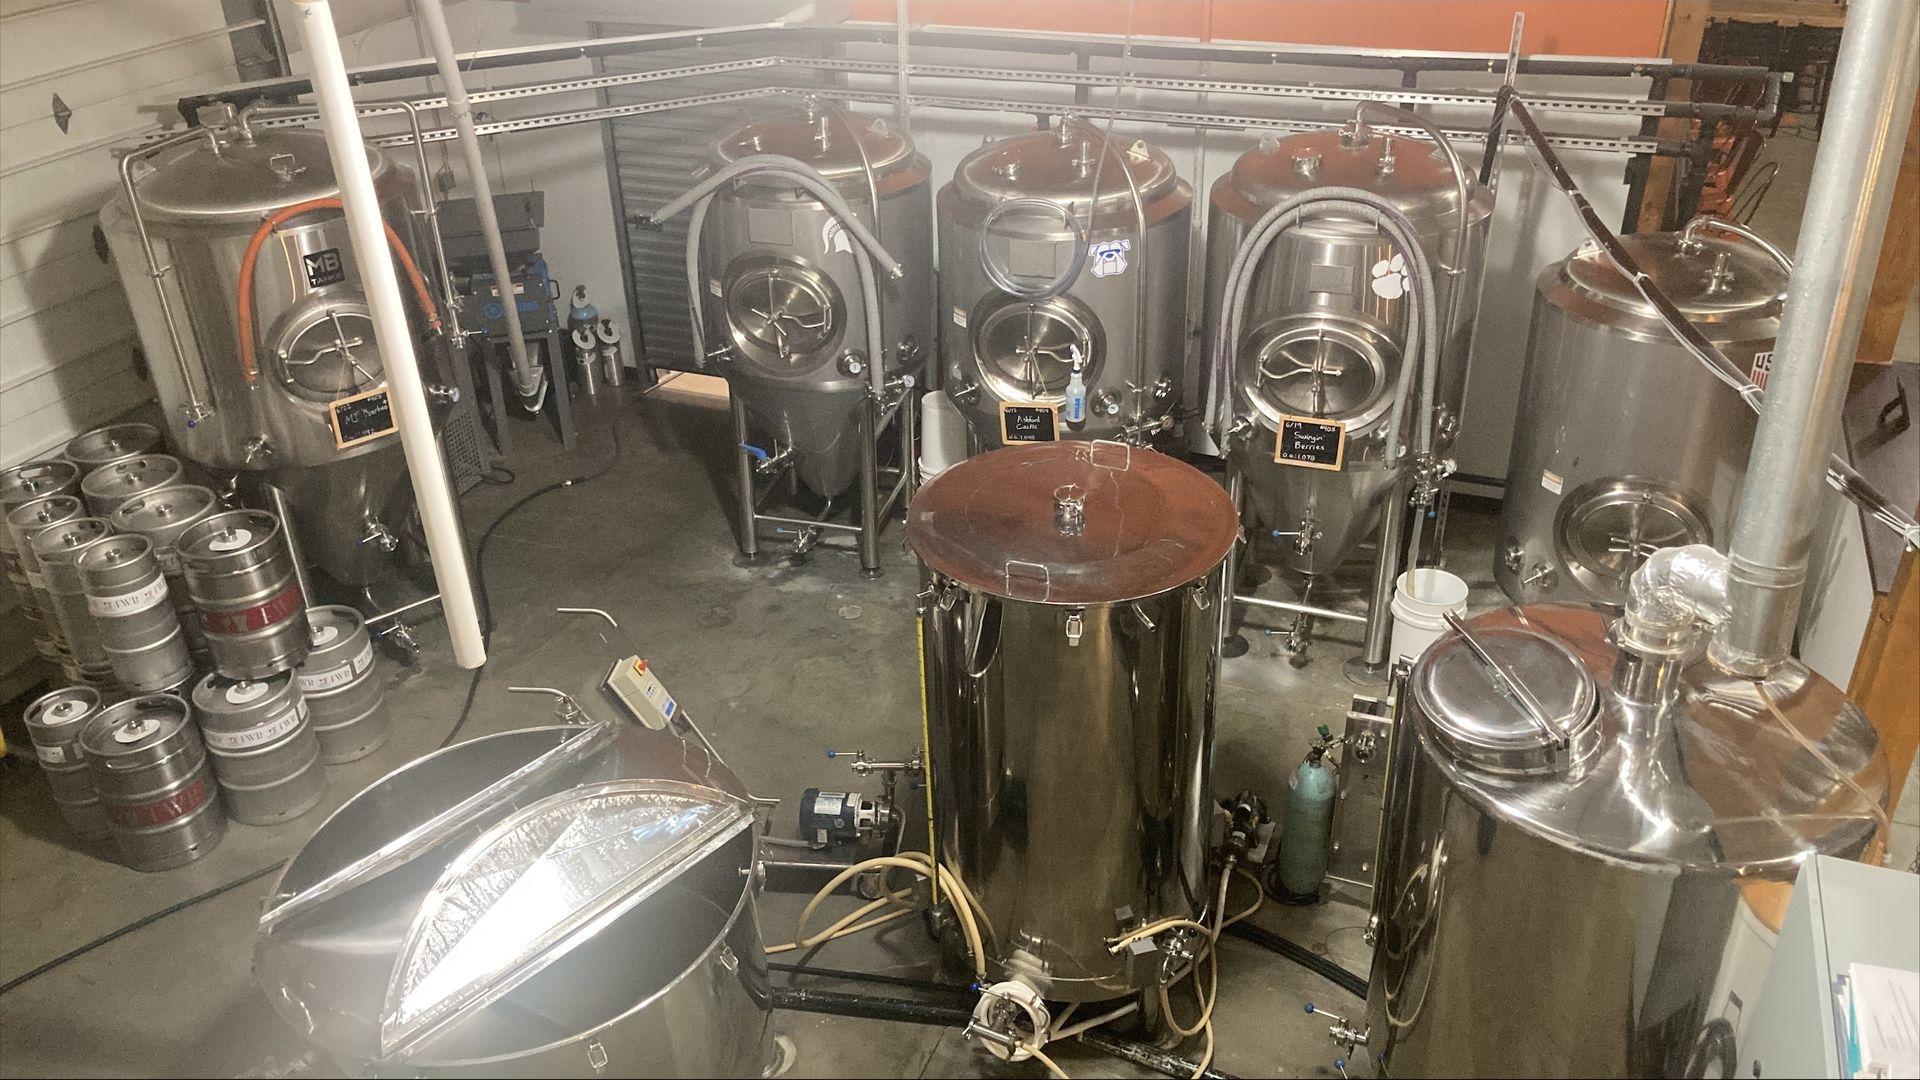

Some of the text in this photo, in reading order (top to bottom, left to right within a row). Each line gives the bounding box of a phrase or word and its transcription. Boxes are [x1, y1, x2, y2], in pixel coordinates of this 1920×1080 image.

[305, 252, 339, 276] MB
[1285, 422, 1302, 430] 6/19
[1294, 441, 1325, 451] Berries
